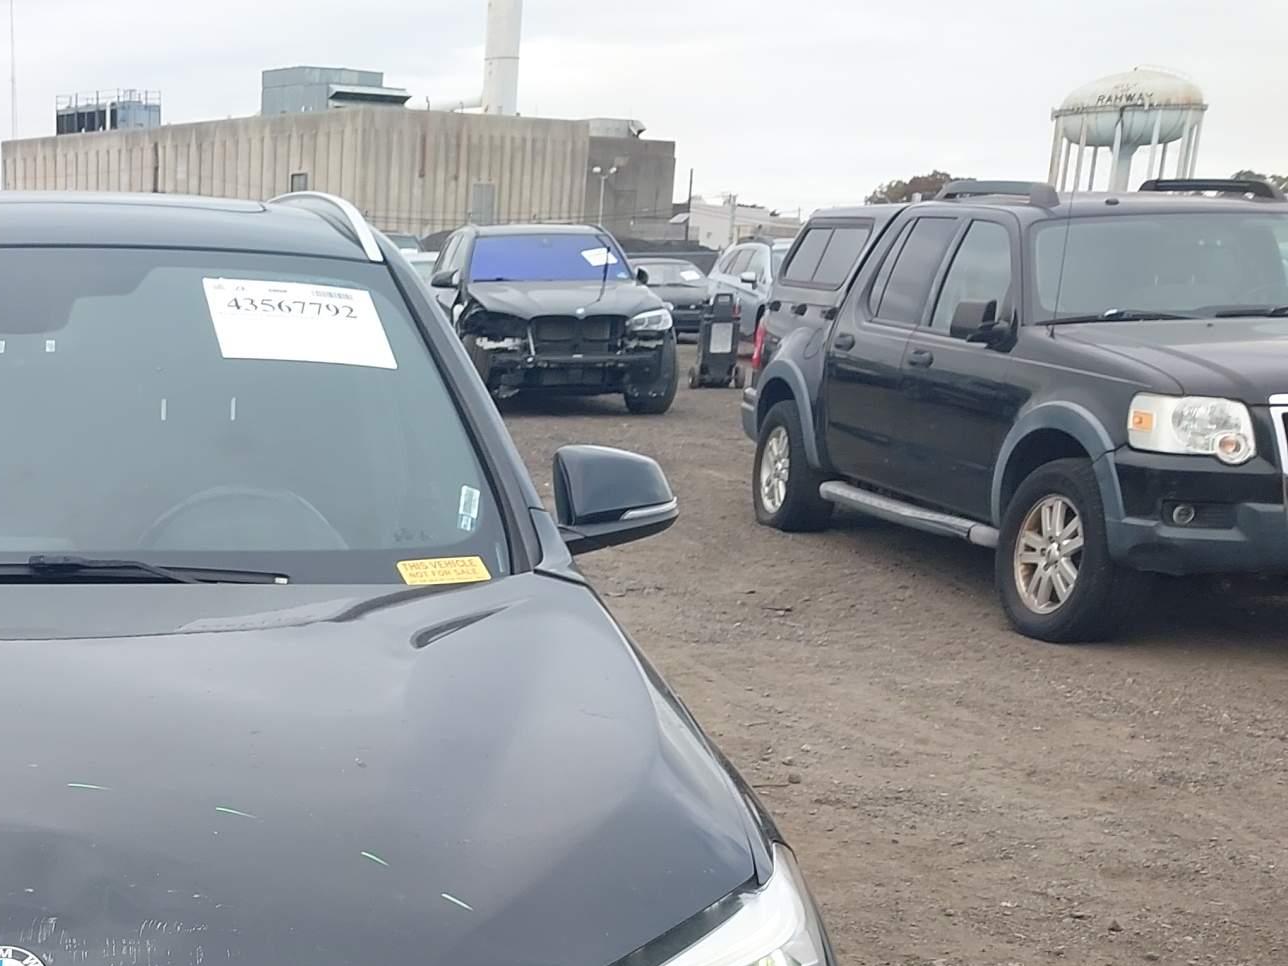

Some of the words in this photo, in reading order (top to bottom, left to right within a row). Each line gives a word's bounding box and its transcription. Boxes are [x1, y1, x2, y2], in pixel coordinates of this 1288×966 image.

[1096, 92, 1154, 106] RAHWAY
[226, 297, 358, 319] 43567792
[402, 561, 429, 571] THIS
[431, 559, 477, 570] VEHICLE
[409, 570, 428, 579] NOT
[431, 569, 451, 577] FOR
[454, 567, 478, 576] SALE
